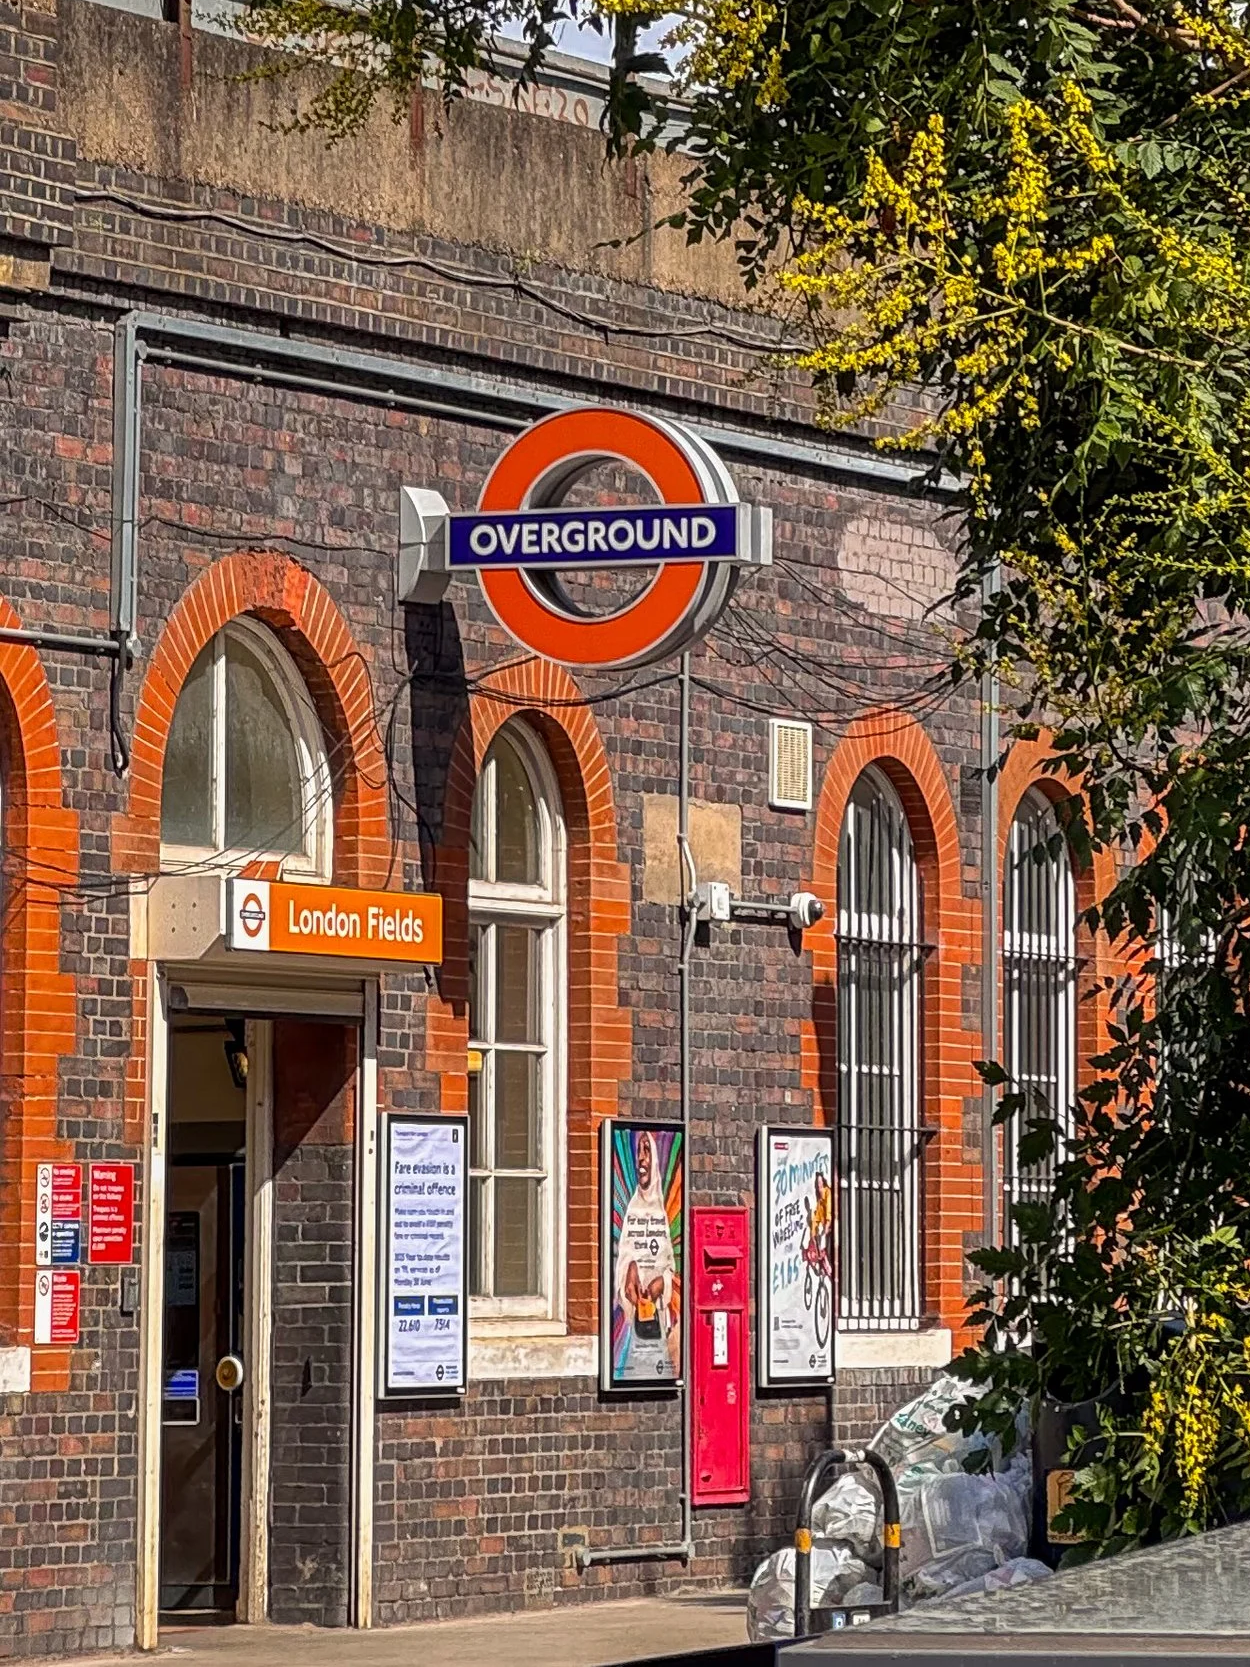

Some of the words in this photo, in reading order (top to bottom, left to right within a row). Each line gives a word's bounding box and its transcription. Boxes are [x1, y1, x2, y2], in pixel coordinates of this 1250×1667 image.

[469, 517, 716, 556] OVERGROUND
[288, 900, 361, 938] London
[367, 906, 424, 944] Fields
[394, 1161, 411, 1175] Fare
[412, 1162, 441, 1175] evasion
[394, 1182, 425, 1195] criminal
[426, 1182, 456, 1195] offence
